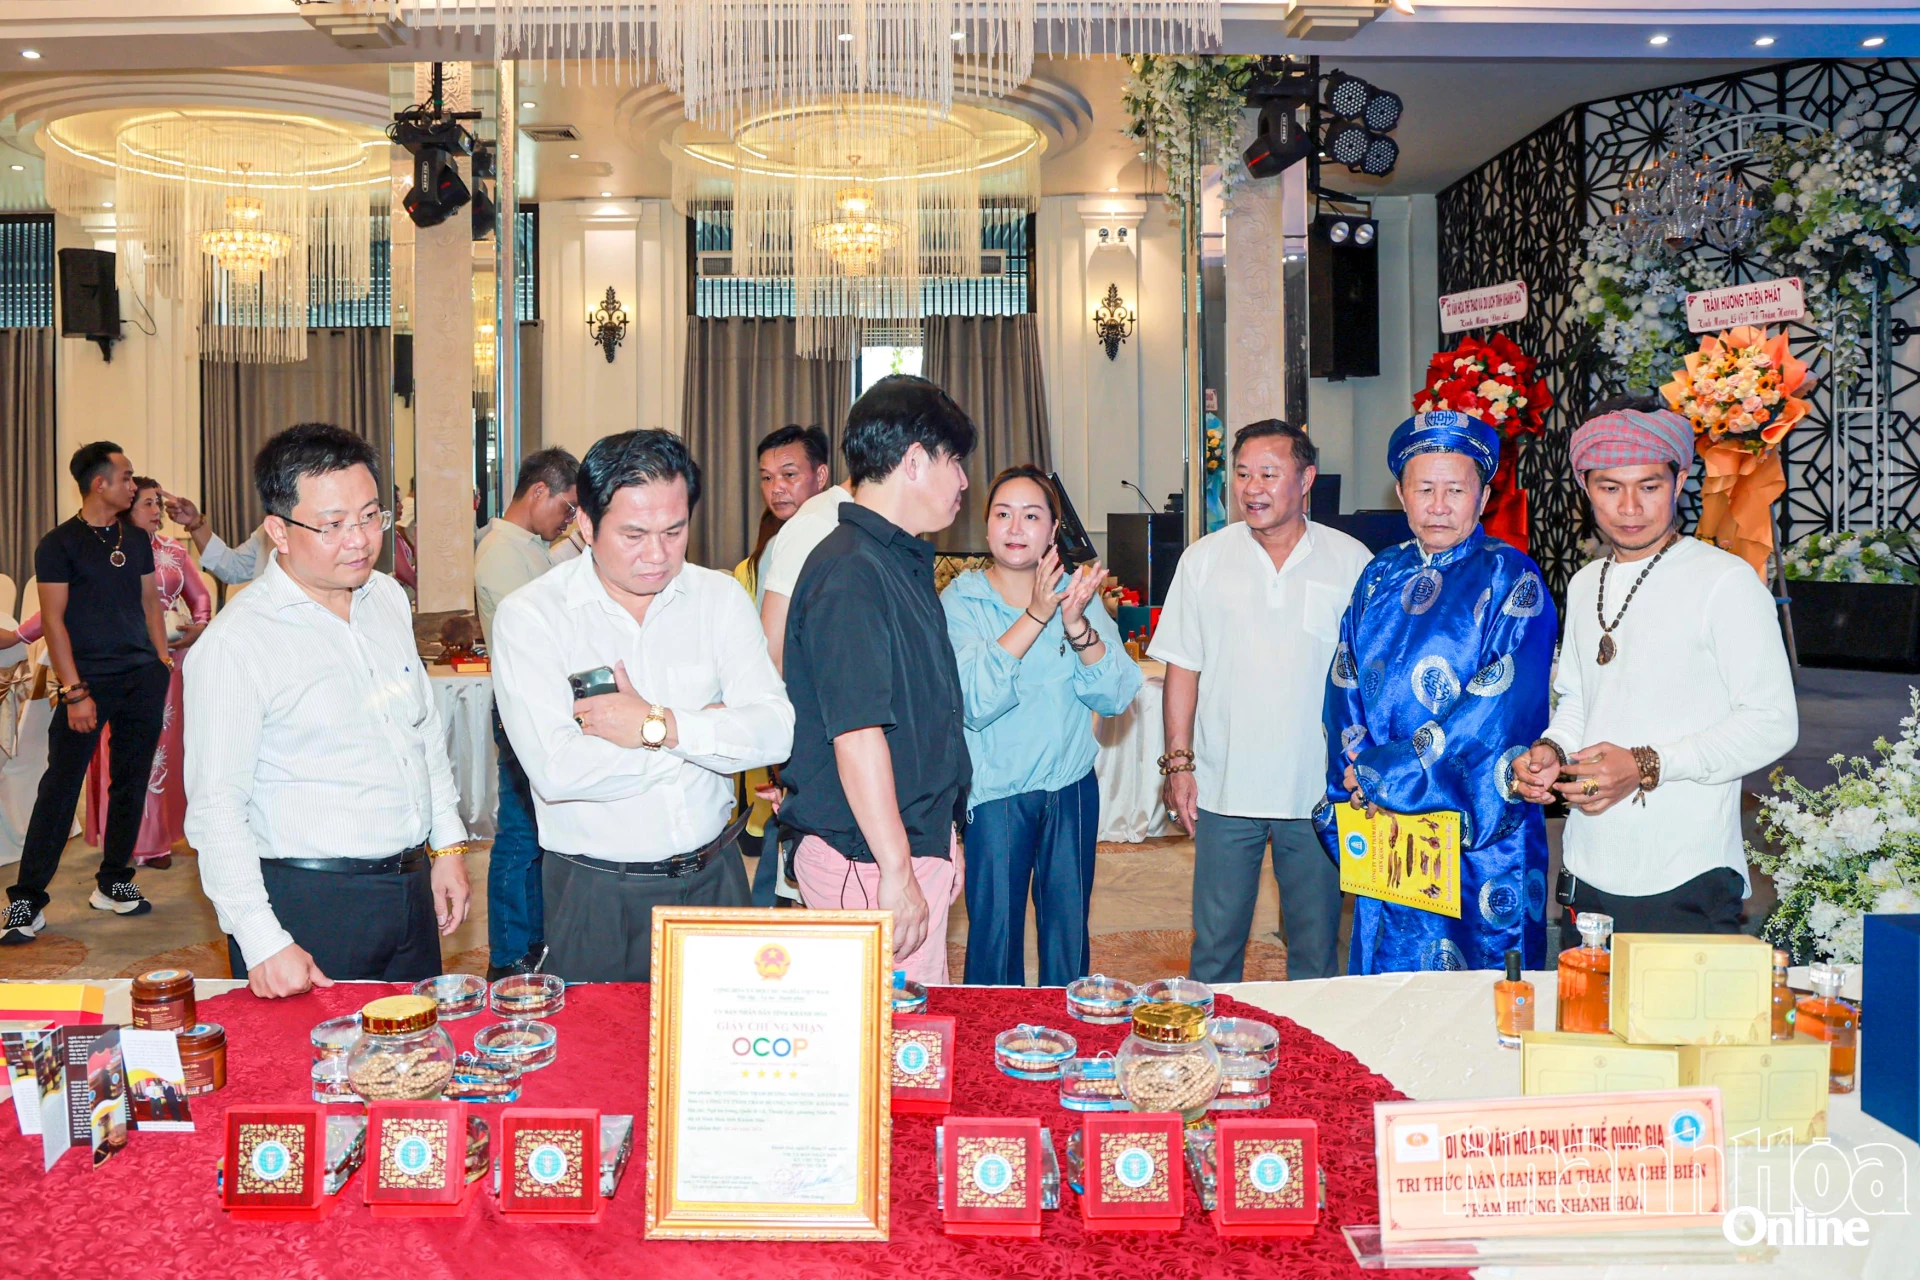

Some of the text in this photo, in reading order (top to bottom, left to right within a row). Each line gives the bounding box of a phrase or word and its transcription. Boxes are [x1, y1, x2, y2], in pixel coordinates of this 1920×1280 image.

[1764, 284, 1781, 304] PHÁT
[732, 1036, 809, 1058] OCOP
[1446, 1134, 1457, 1160] DI
[1540, 1129, 1560, 1155] PHI
[1645, 1124, 1666, 1149] GIA
[1397, 1177, 1420, 1193] TRI
[1500, 1172, 1533, 1188] GIAN
[1538, 1170, 1572, 1187] KHAI
